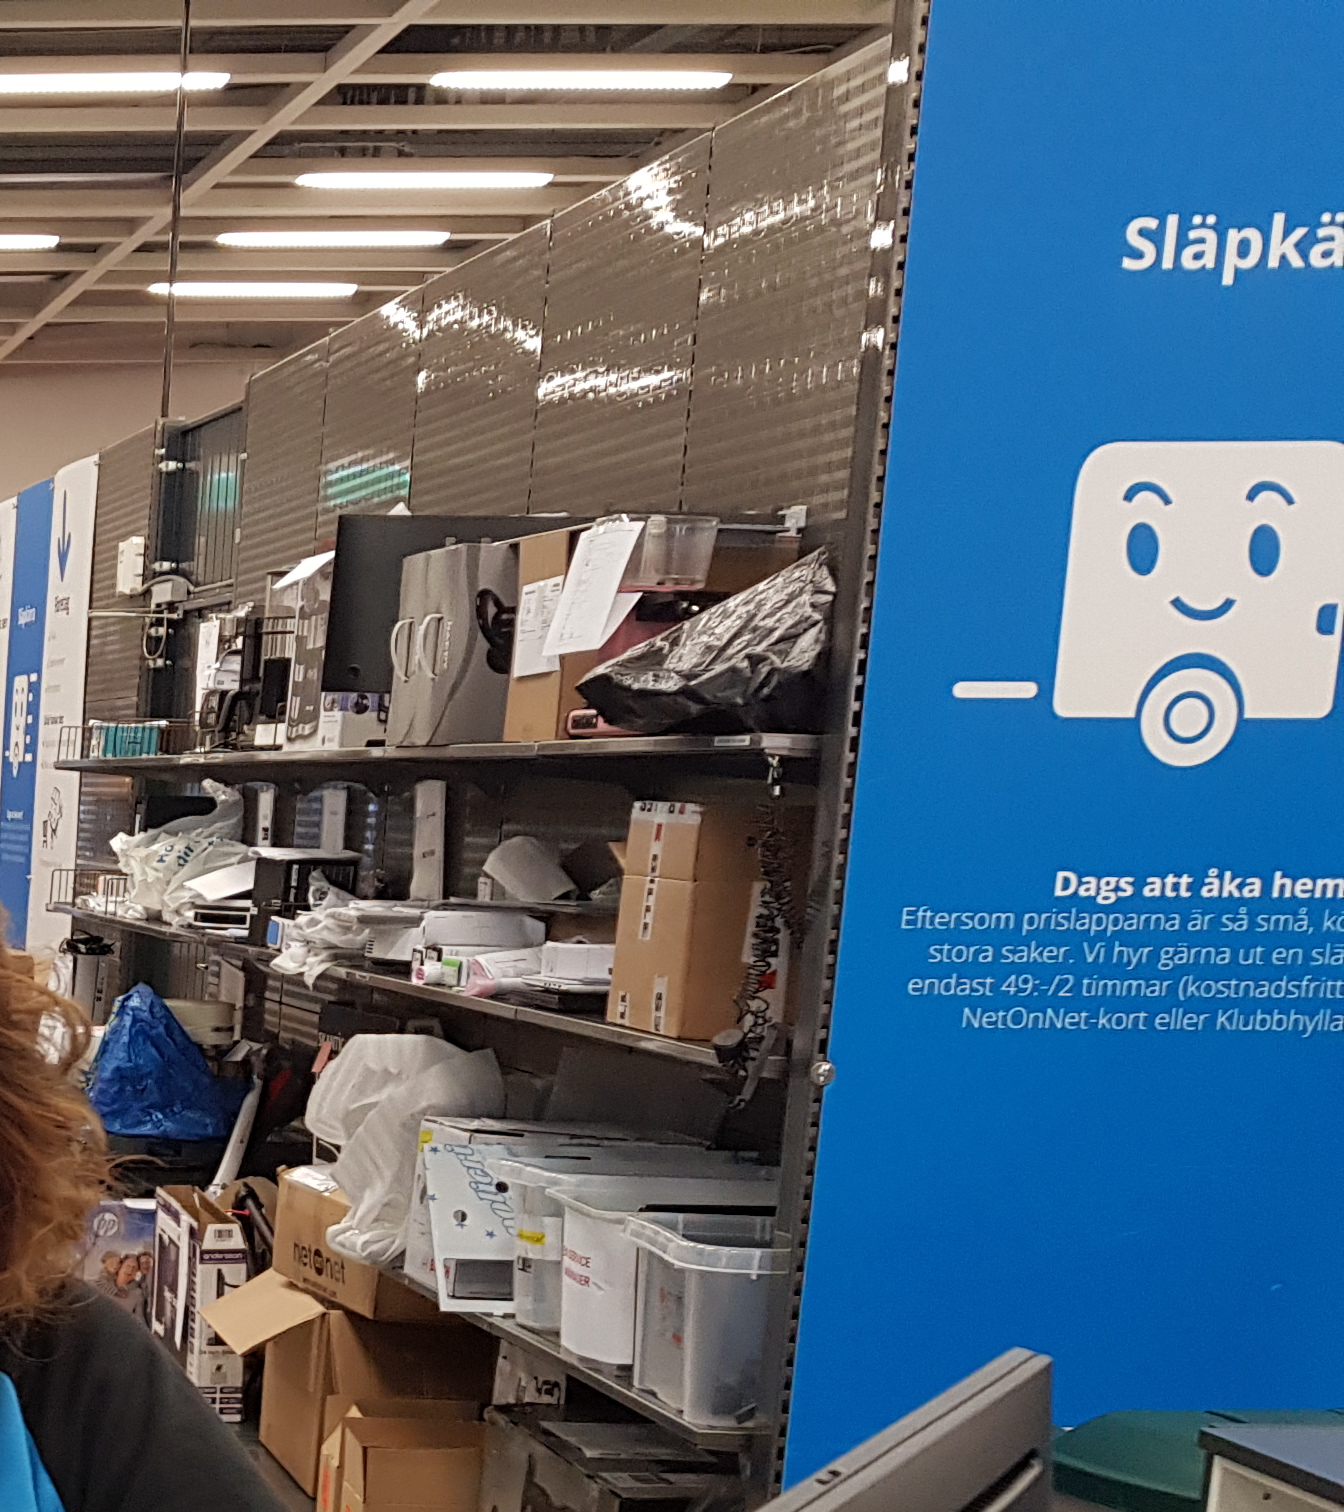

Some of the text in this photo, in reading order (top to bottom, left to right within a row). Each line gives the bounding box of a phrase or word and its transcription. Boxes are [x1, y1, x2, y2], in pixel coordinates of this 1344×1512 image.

[1121, 211, 1344, 286] Släpkä
[1053, 867, 1344, 905] Dags att åka hem
[900, 904, 1314, 937] Eftersom prislapparna är så små,
[927, 942, 994, 963] stora
[999, 940, 1075, 964] saker.
[1082, 941, 1106, 964] Vi
[1112, 940, 1154, 970] hyr
[1157, 945, 1231, 971] gärna
[1238, 945, 1266, 966] ut
[1271, 947, 1304, 965] en
[907, 973, 995, 996] endast
[999, 974, 1074, 997] 49:-/2
[1081, 974, 1174, 997] timmar
[961, 1006, 1344, 1038] NetOnNet-kort eller Klubbhylla
